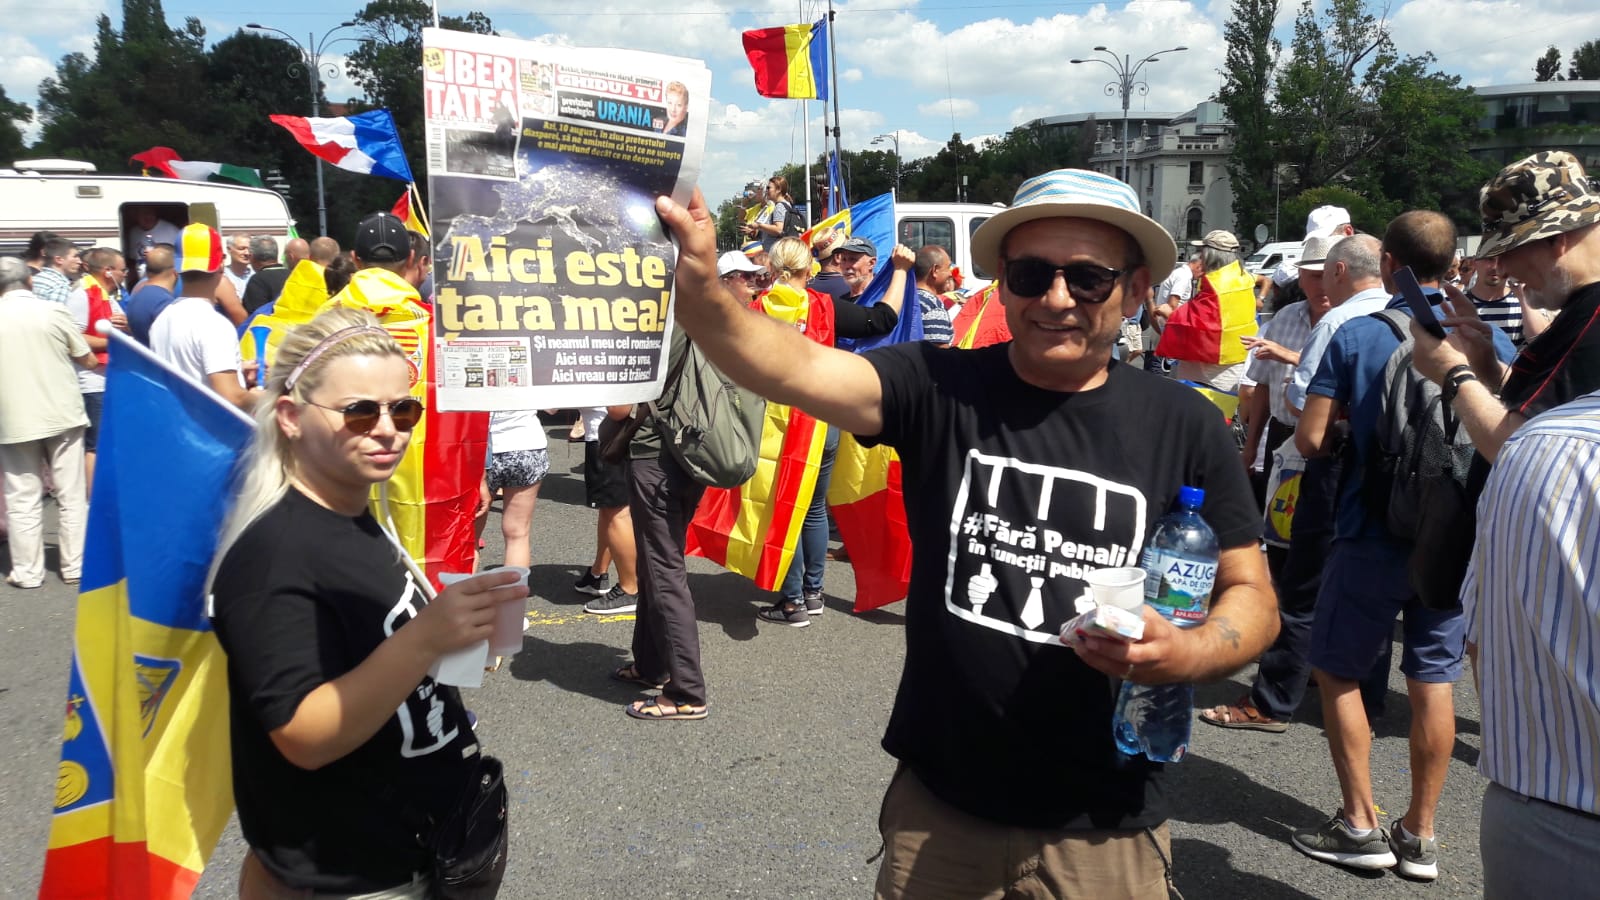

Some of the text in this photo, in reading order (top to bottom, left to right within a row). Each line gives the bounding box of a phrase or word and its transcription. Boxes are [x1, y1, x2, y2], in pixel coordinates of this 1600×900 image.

[558, 74, 632, 96] GHIDUL
[636, 86, 660, 101] TV
[598, 100, 652, 128] URANIA
[560, 122, 568, 132] 10
[609, 130, 624, 140] ziua
[626, 132, 666, 148] protestului
[572, 135, 582, 144] ne
[583, 136, 615, 149] amintim
[626, 143, 636, 153] tot
[638, 146, 646, 154] ce
[647, 148, 656, 156] ne
[544, 140, 558, 150] mai
[559, 142, 591, 156] profund
[612, 151, 621, 160] ce
[622, 152, 632, 161] ne
[632, 153, 664, 167] desparte
[447, 236, 666, 288] Aici este
[562, 292, 670, 332] mea!
[534, 335, 546, 352] Și
[548, 336, 589, 349] neamul
[592, 338, 614, 350] meu
[616, 336, 629, 350] cel
[555, 352, 576, 366] Aici
[578, 354, 592, 366] eu
[594, 352, 606, 366] să
[608, 355, 626, 366] mor
[552, 368, 574, 382] Aici
[576, 370, 605, 382] vreau
[606, 371, 618, 382] eu
[619, 368, 628, 382] să
[964, 512, 1127, 568] #Fără Penali
[968, 538, 986, 556] în
[1050, 560, 1096, 582] publ
[1189, 580, 1199, 588] DE
